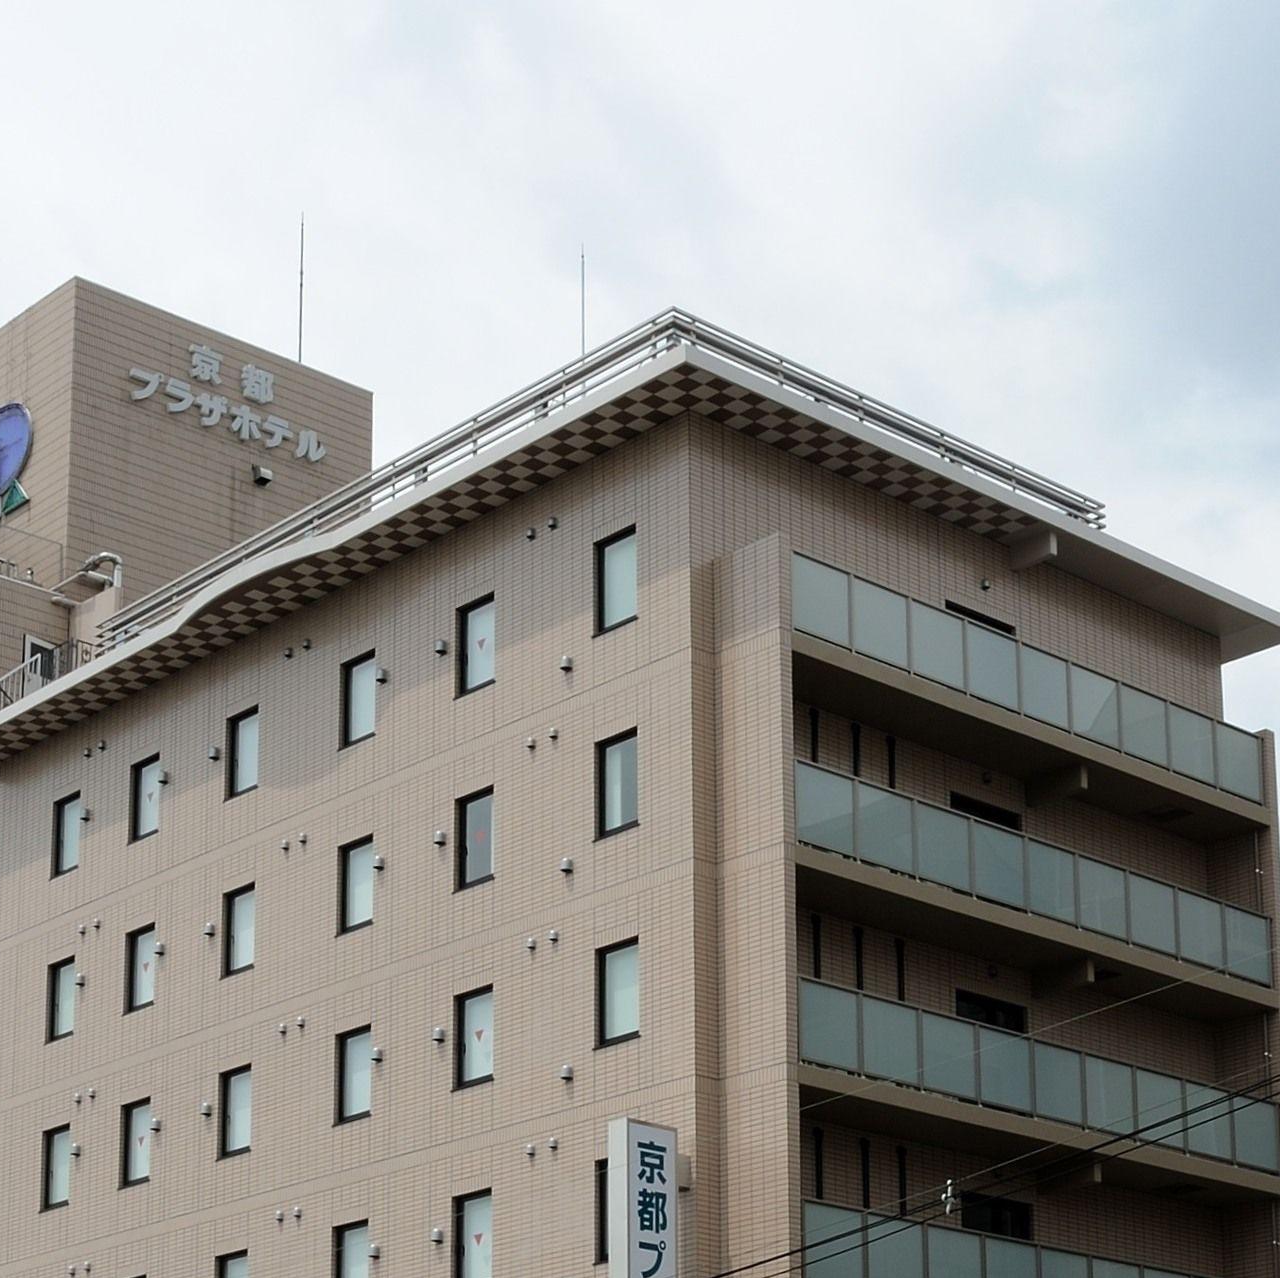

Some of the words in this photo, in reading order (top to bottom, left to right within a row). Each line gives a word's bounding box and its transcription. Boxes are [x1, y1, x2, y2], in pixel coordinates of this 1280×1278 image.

[188, 343, 276, 404] 京都
[128, 367, 327, 464] プラザホテル
